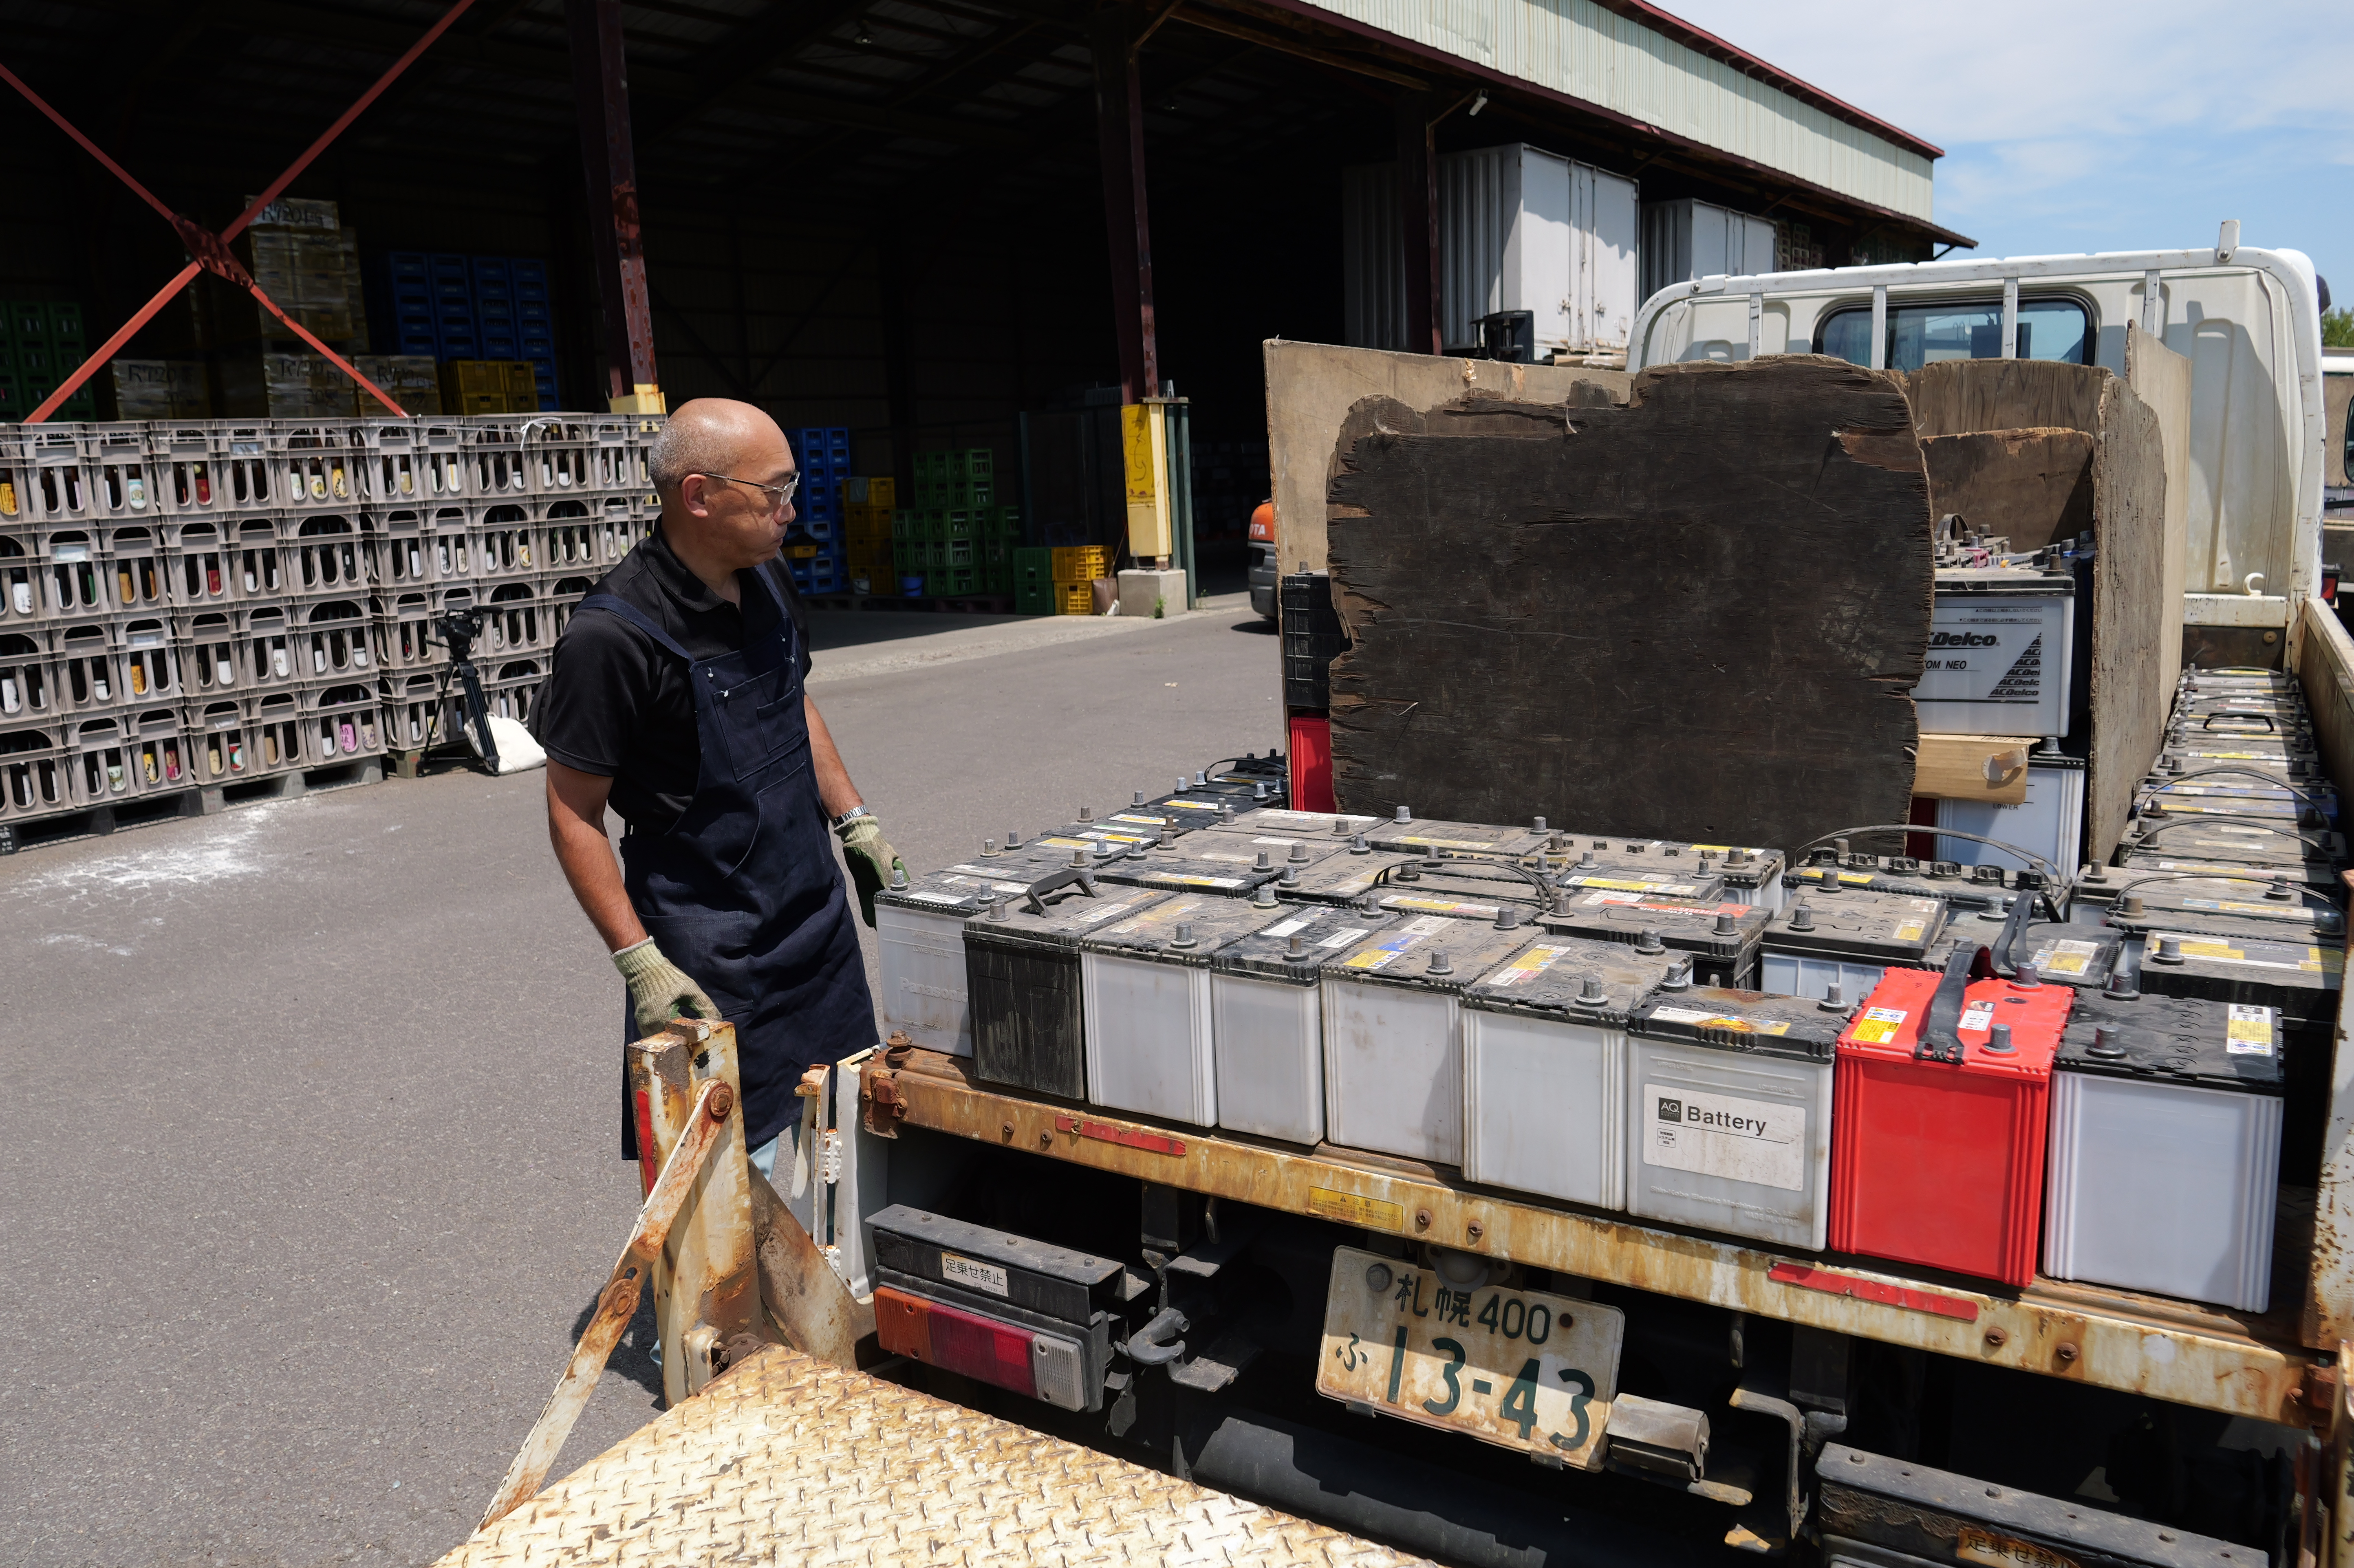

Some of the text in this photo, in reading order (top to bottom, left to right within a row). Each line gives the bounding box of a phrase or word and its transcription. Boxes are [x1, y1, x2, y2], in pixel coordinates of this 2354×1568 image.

[1946, 660, 1966, 669] NEO
[911, 930, 949, 942] UPPER LEVEL
[913, 945, 950, 958] LOWER LEVEL
[899, 977, 968, 1003] Panasonic
[1759, 1083, 1796, 1094] LOWER LEVEL
[1688, 1106, 1767, 1136] Battery
[1650, 1185, 1689, 1198] Shin-Kobe
[1691, 1193, 1721, 1204] Electric
[1722, 1199, 1763, 1213] Machinery
[1745, 1211, 1763, 1220] MADE
[1774, 1216, 1799, 1227] JAPAN
[946, 1258, 1003, 1286] 足乗せ禁止
[1336, 1332, 1368, 1372] ふ
[1966, 1535, 2069, 1568] 足乗せ禁
